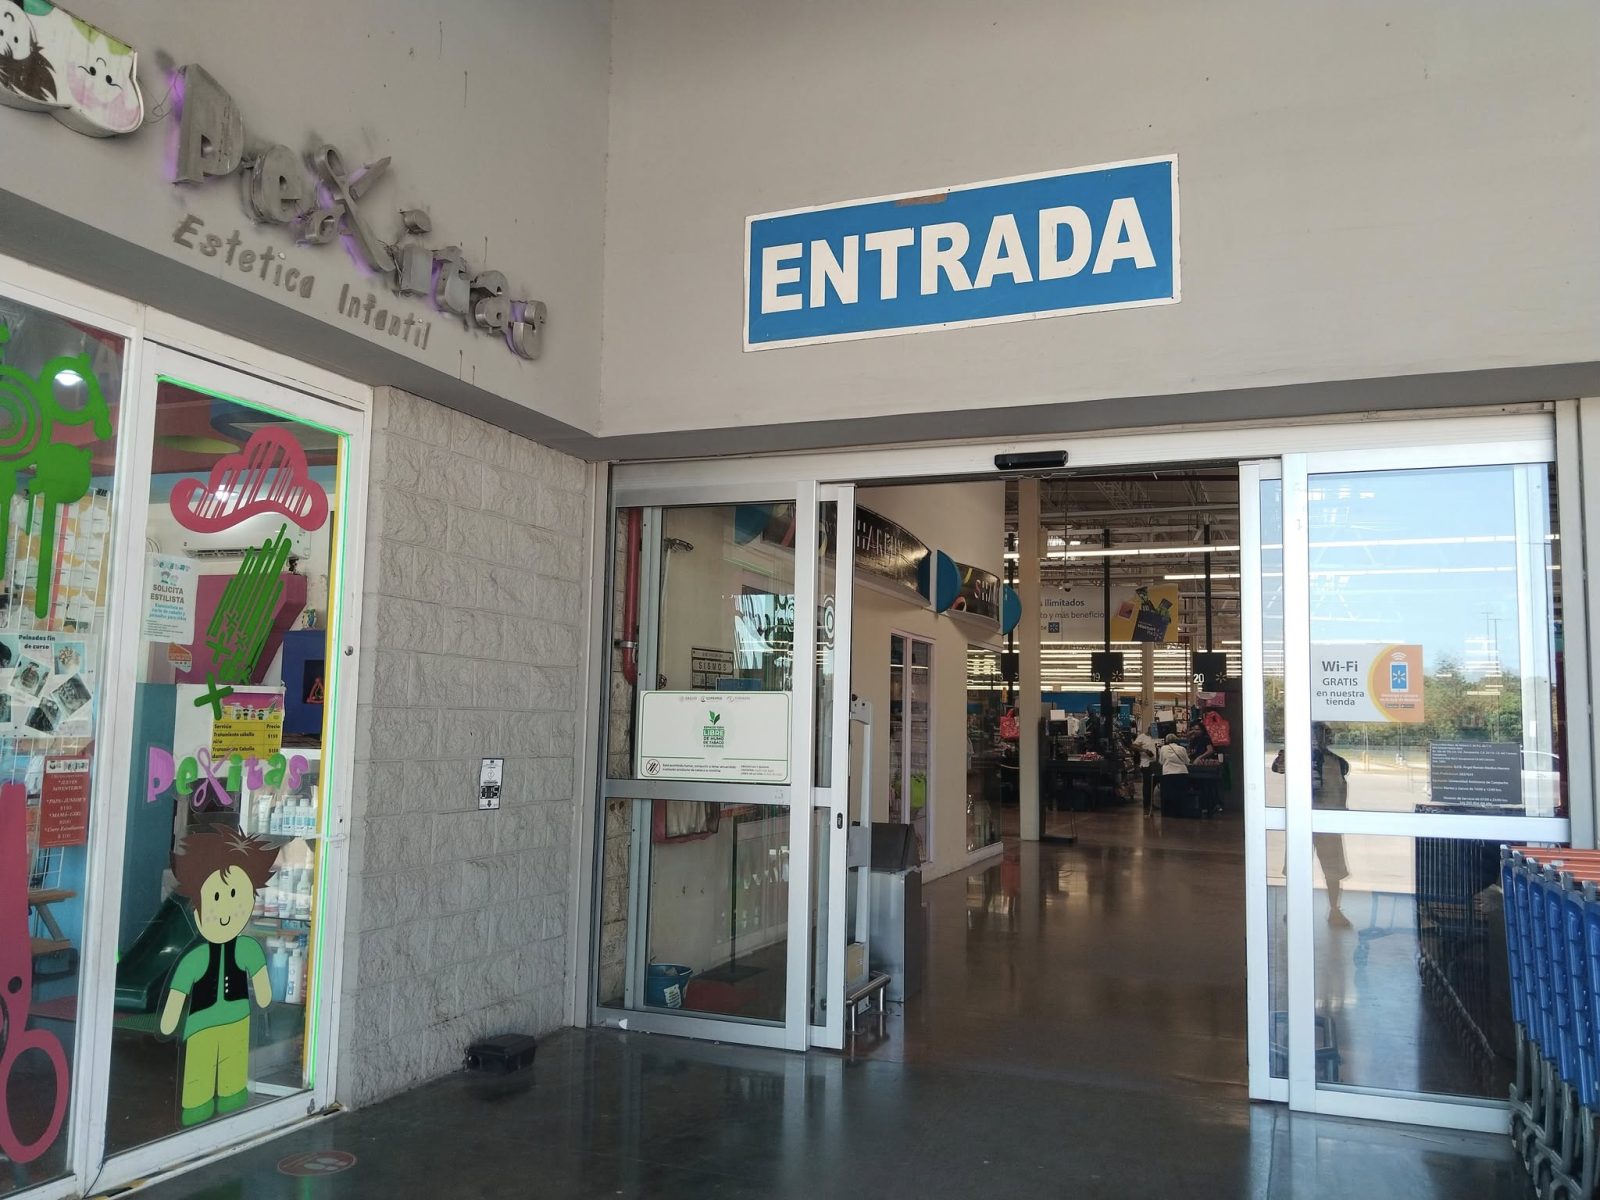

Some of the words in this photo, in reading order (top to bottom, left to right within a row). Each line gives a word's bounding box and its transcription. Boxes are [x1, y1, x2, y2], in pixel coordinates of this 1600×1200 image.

[761, 197, 1156, 314] ENTRADA
[172, 213, 316, 299] Estetica
[337, 283, 432, 350] Infantil
[153, 584, 184, 595] SOLICITA
[150, 593, 184, 604] ESTILISTA
[698, 661, 727, 672] SISMOS
[1321, 660, 1359, 673] Wi-Fi
[1092, 672, 1101, 682] 19
[1193, 673, 1205, 684] 20
[1322, 677, 1359, 687] GRATIS
[1330, 690, 1365, 698] nuestra
[1325, 697, 1356, 706] tienda
